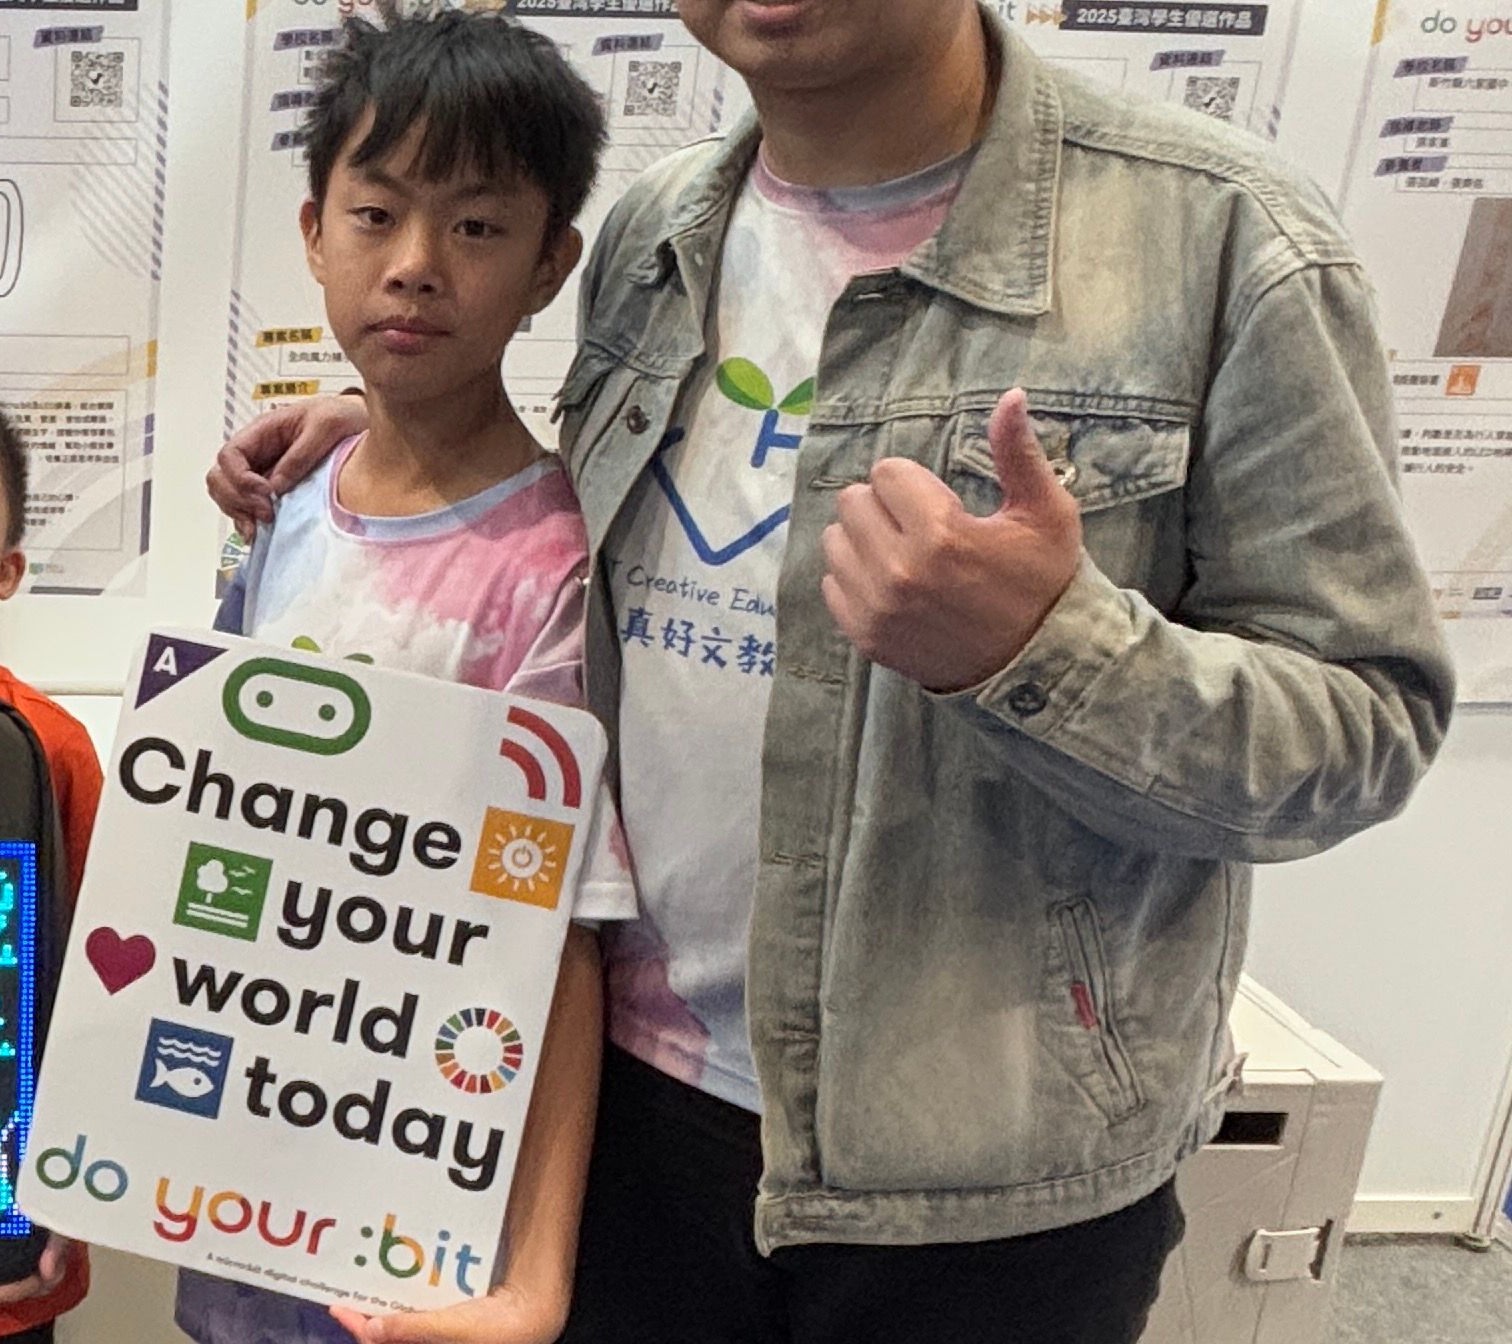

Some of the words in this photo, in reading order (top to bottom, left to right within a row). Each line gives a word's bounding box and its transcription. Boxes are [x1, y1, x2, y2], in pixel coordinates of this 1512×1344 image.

[1421, 11, 1457, 36] do
[626, 564, 721, 607] Creative
[152, 646, 178, 676] A
[619, 606, 777, 678] 真好文教
[118, 736, 462, 878] Change
[276, 875, 490, 967] your
[173, 955, 418, 1059] world
[243, 1055, 505, 1193] today
[35, 1133, 129, 1202] do
[152, 1176, 336, 1256] your
[354, 1212, 484, 1296] :bit
[264, 1268, 298, 1284] digital
[299, 1278, 350, 1298] challenge
[353, 1291, 368, 1302] for
[370, 1296, 389, 1308] the
